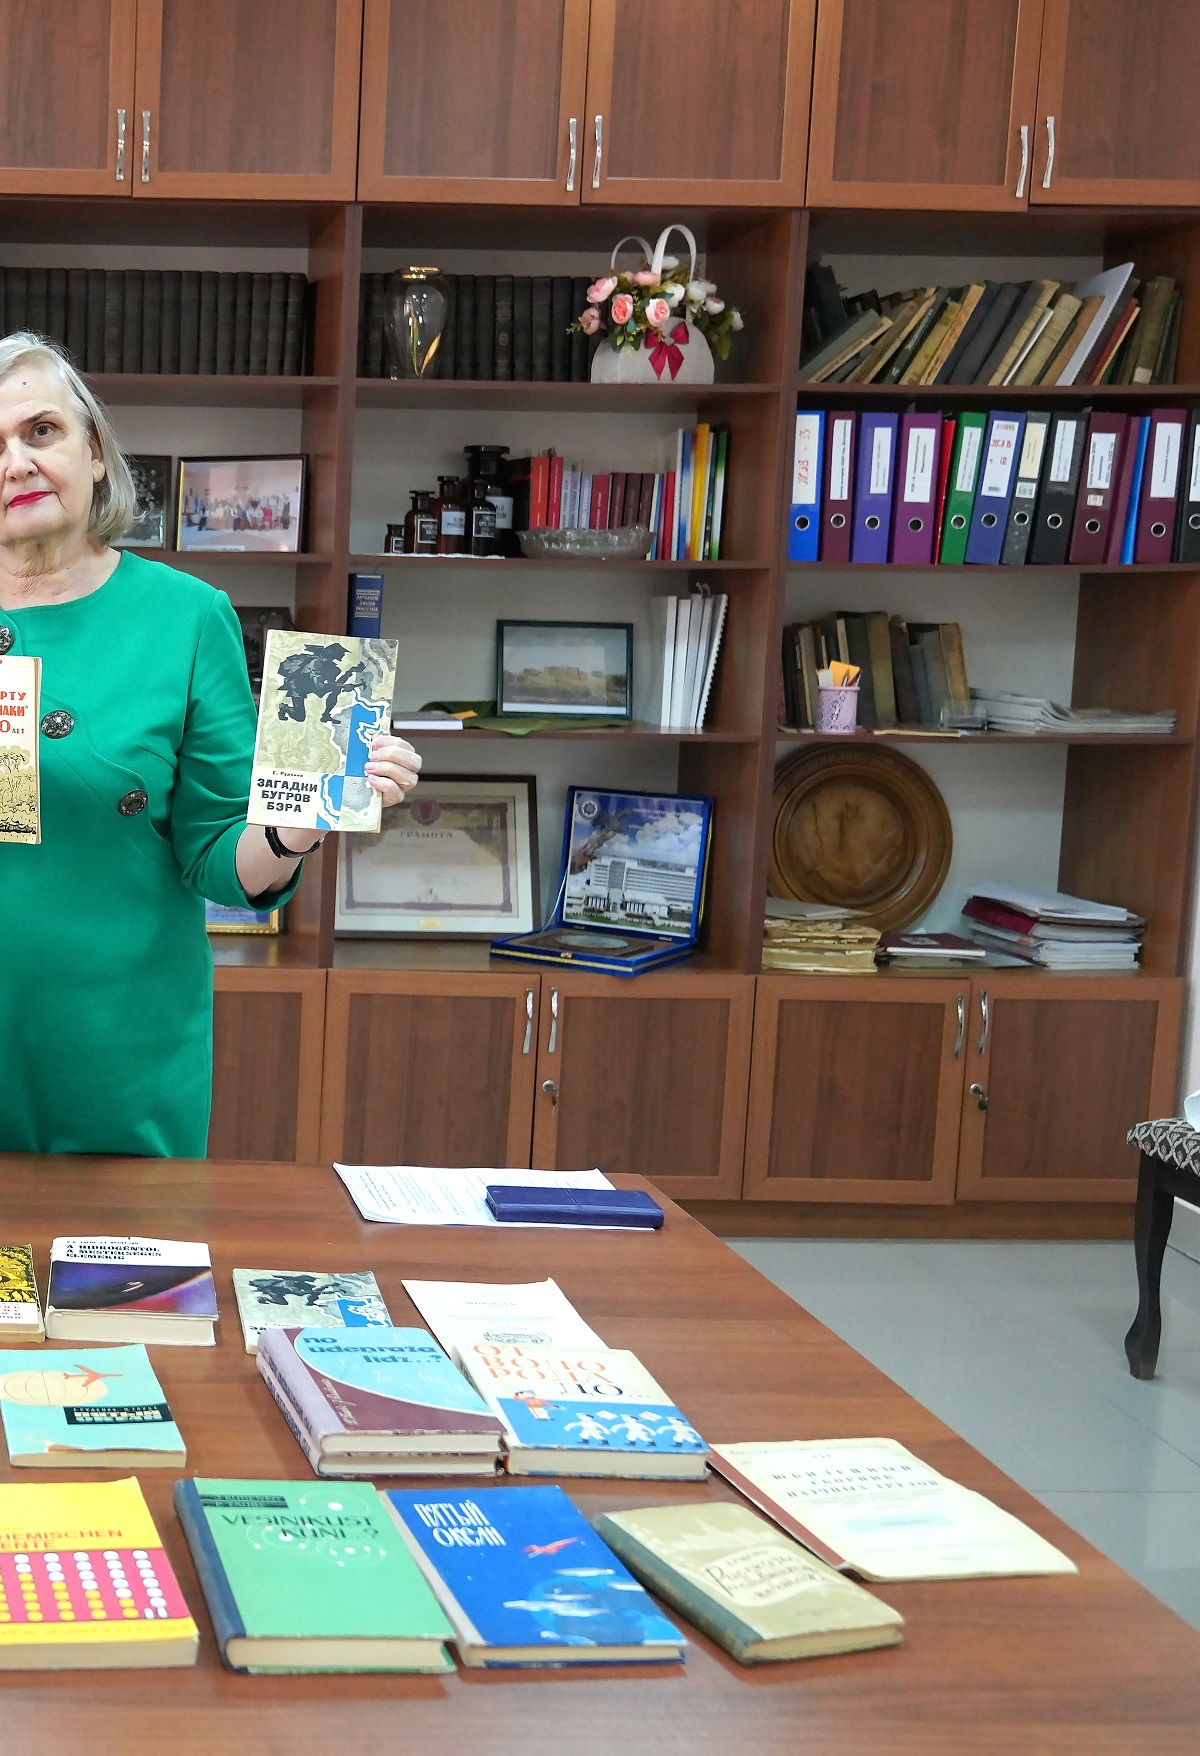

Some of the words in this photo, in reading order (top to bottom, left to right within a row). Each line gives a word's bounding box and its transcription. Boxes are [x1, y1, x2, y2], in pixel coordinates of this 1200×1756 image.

[257, 778, 318, 793] ЗАГАДКИ
[261, 791, 310, 803] БУГРОВ
[266, 801, 302, 813] БЭРА
[473, 1344, 530, 1357] ОТ
[785, 1484, 869, 1498] НАУЧНЫХ
[221, 1513, 373, 1526] VESINIKUST
[413, 1499, 490, 1528] ПЯТЫЙ
